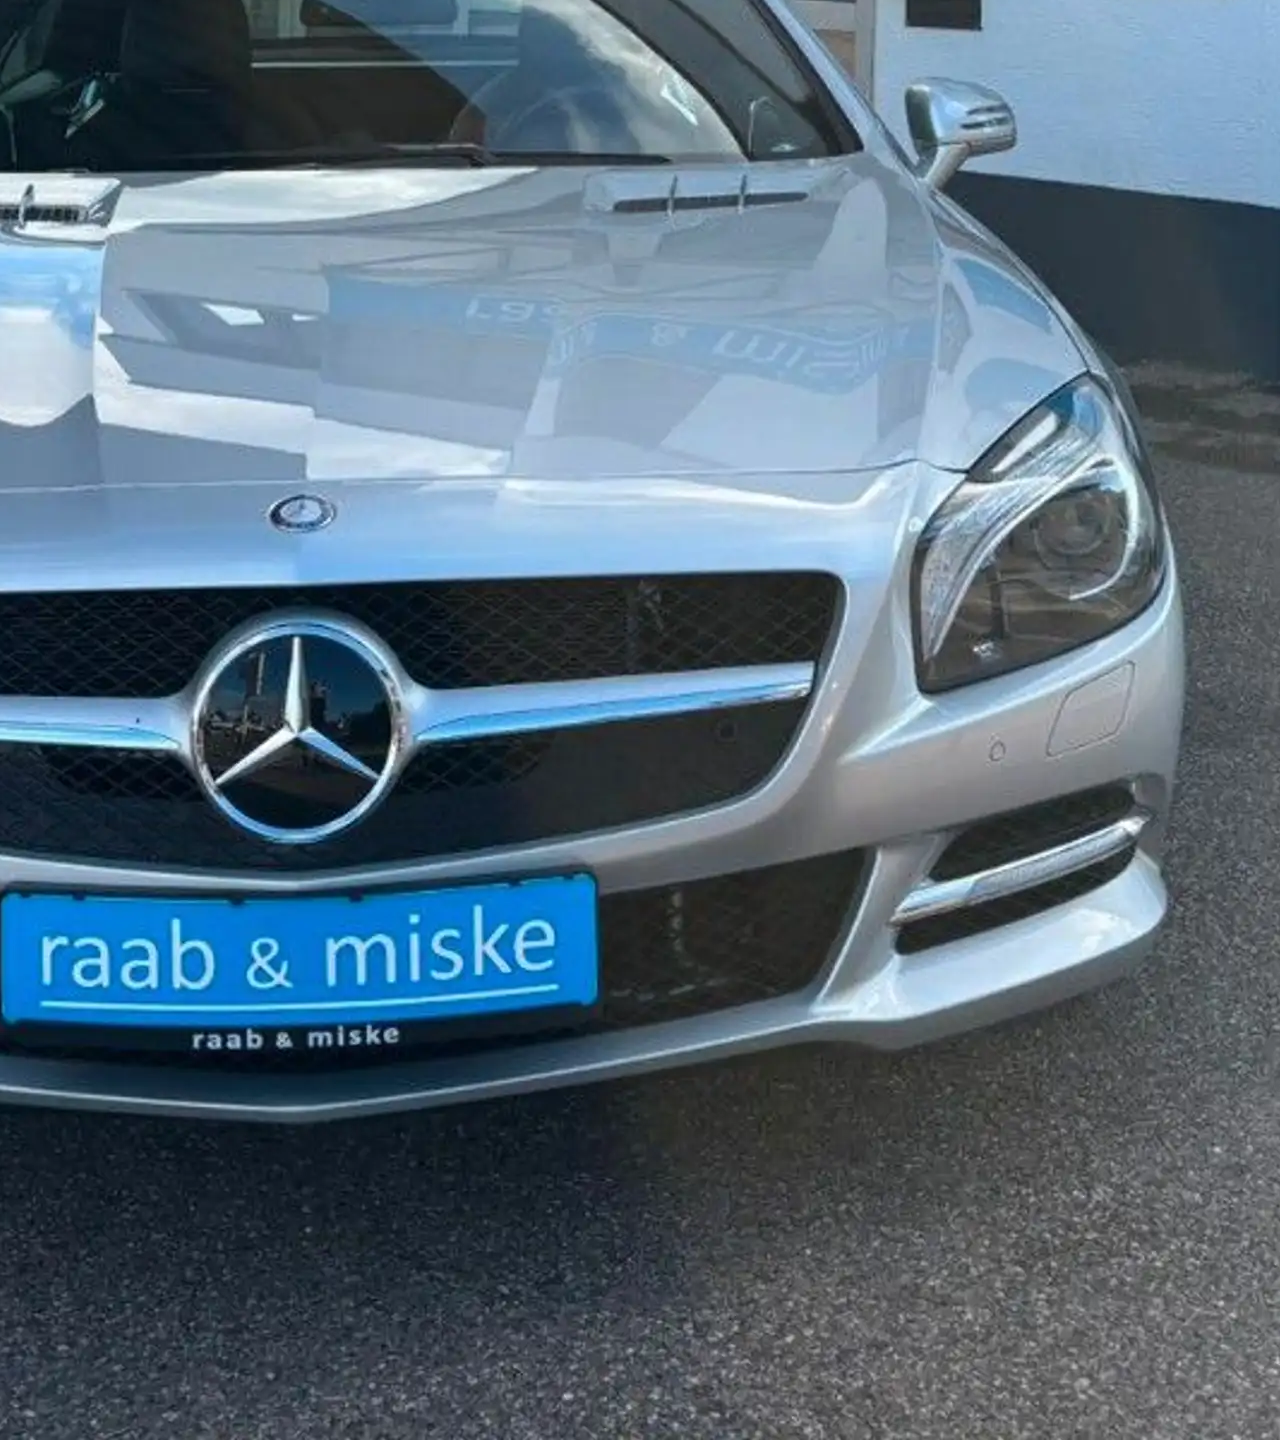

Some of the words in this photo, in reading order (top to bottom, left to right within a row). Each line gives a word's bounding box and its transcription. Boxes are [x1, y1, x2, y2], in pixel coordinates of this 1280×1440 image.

[42, 918, 215, 991] raab
[246, 936, 293, 990] &
[326, 904, 556, 987] miske
[192, 1029, 263, 1050] raab
[275, 1032, 294, 1049] &
[308, 1024, 401, 1047] miske
